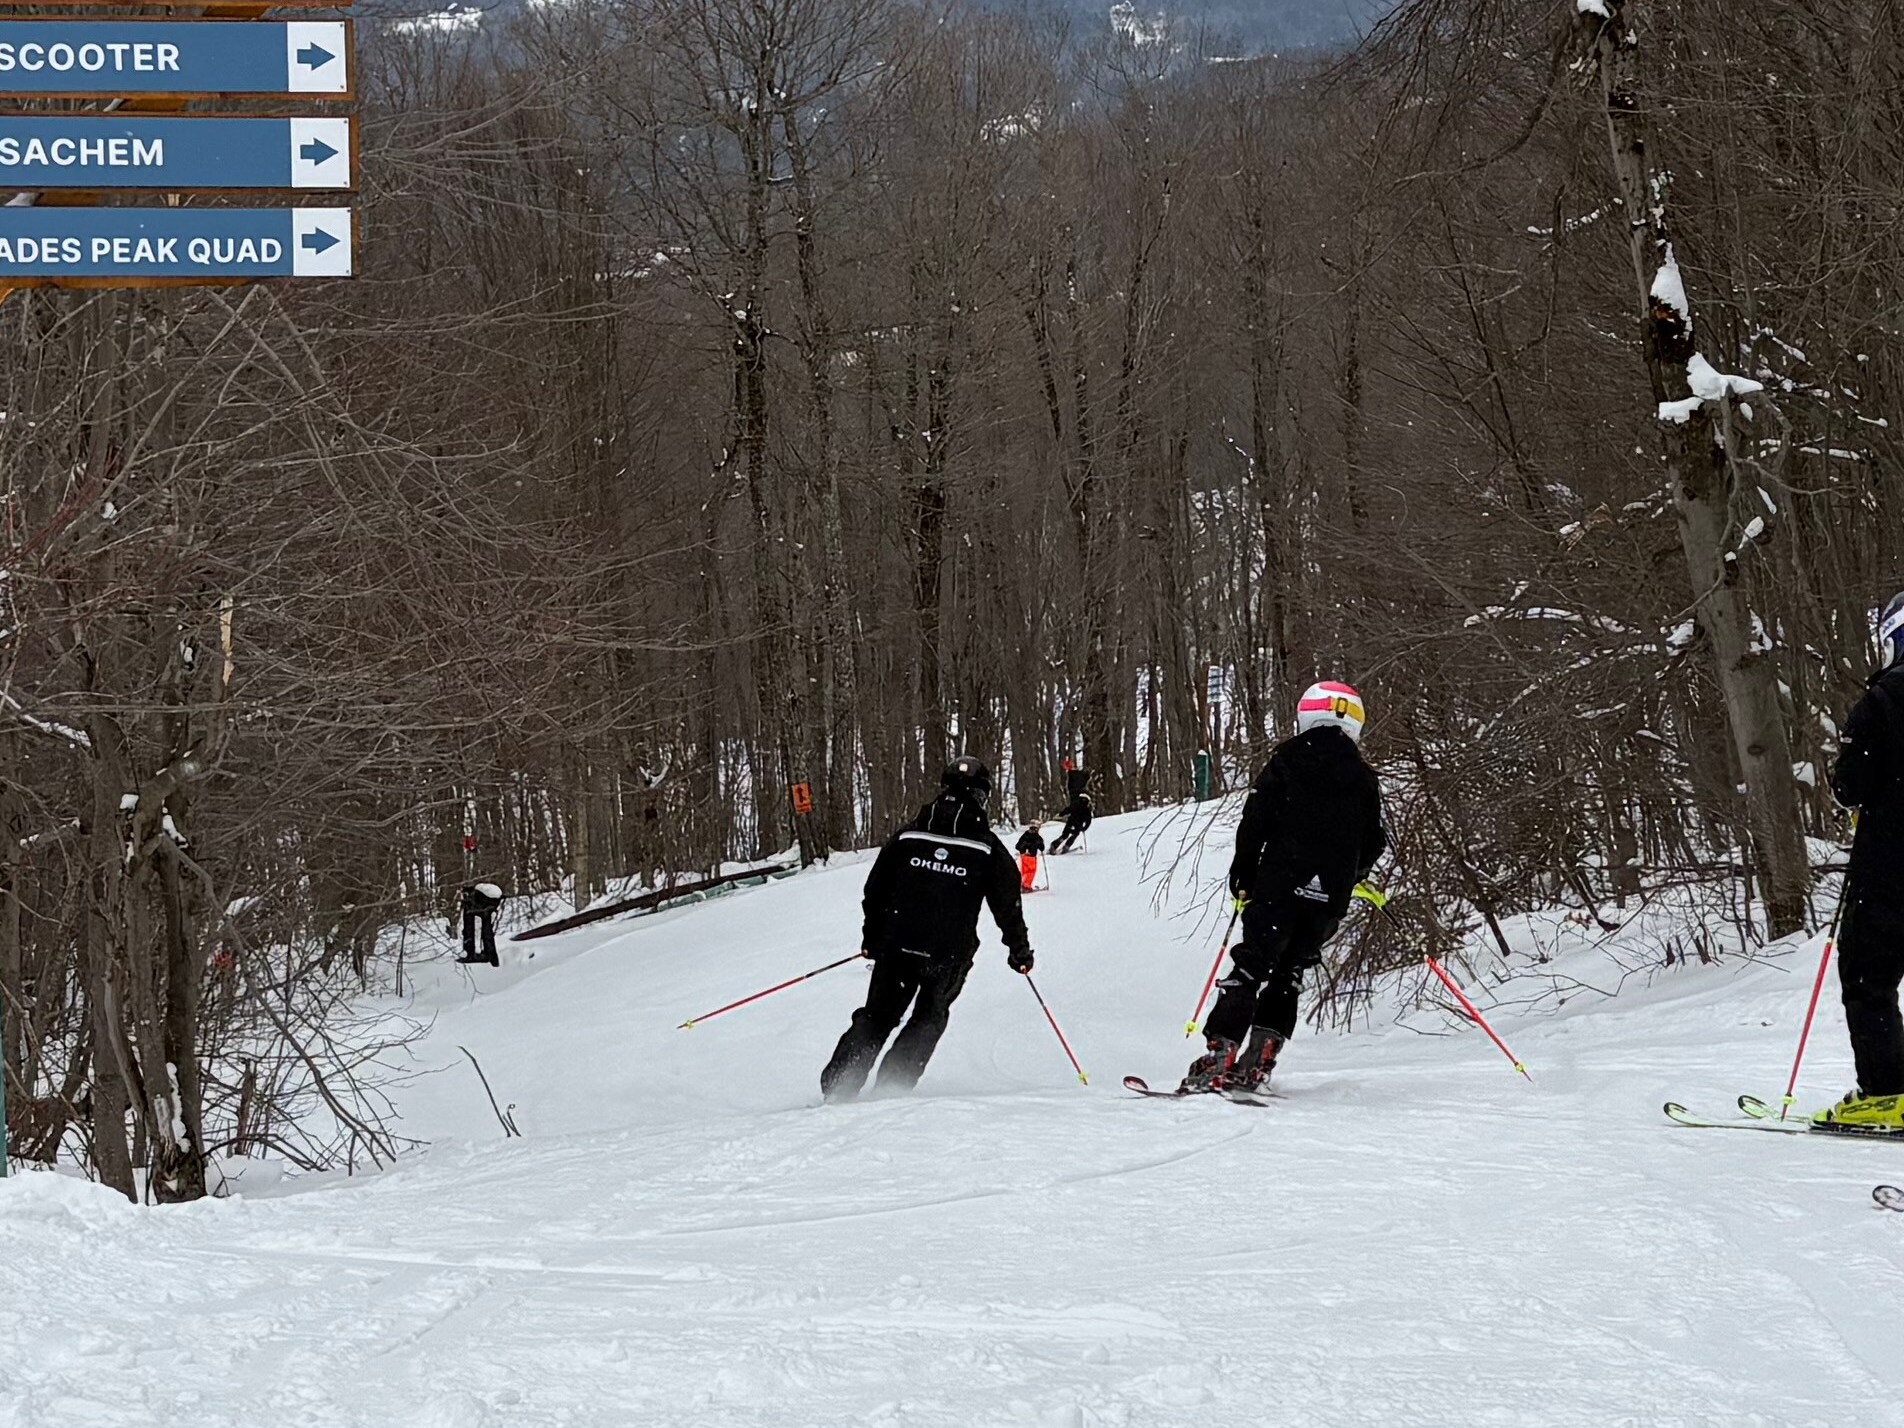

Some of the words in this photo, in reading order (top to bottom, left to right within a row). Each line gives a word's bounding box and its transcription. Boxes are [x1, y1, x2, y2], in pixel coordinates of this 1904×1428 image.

[91, 237, 179, 263] PEAK
[187, 237, 282, 265] QUAD
[910, 857, 967, 876] OKEMO
